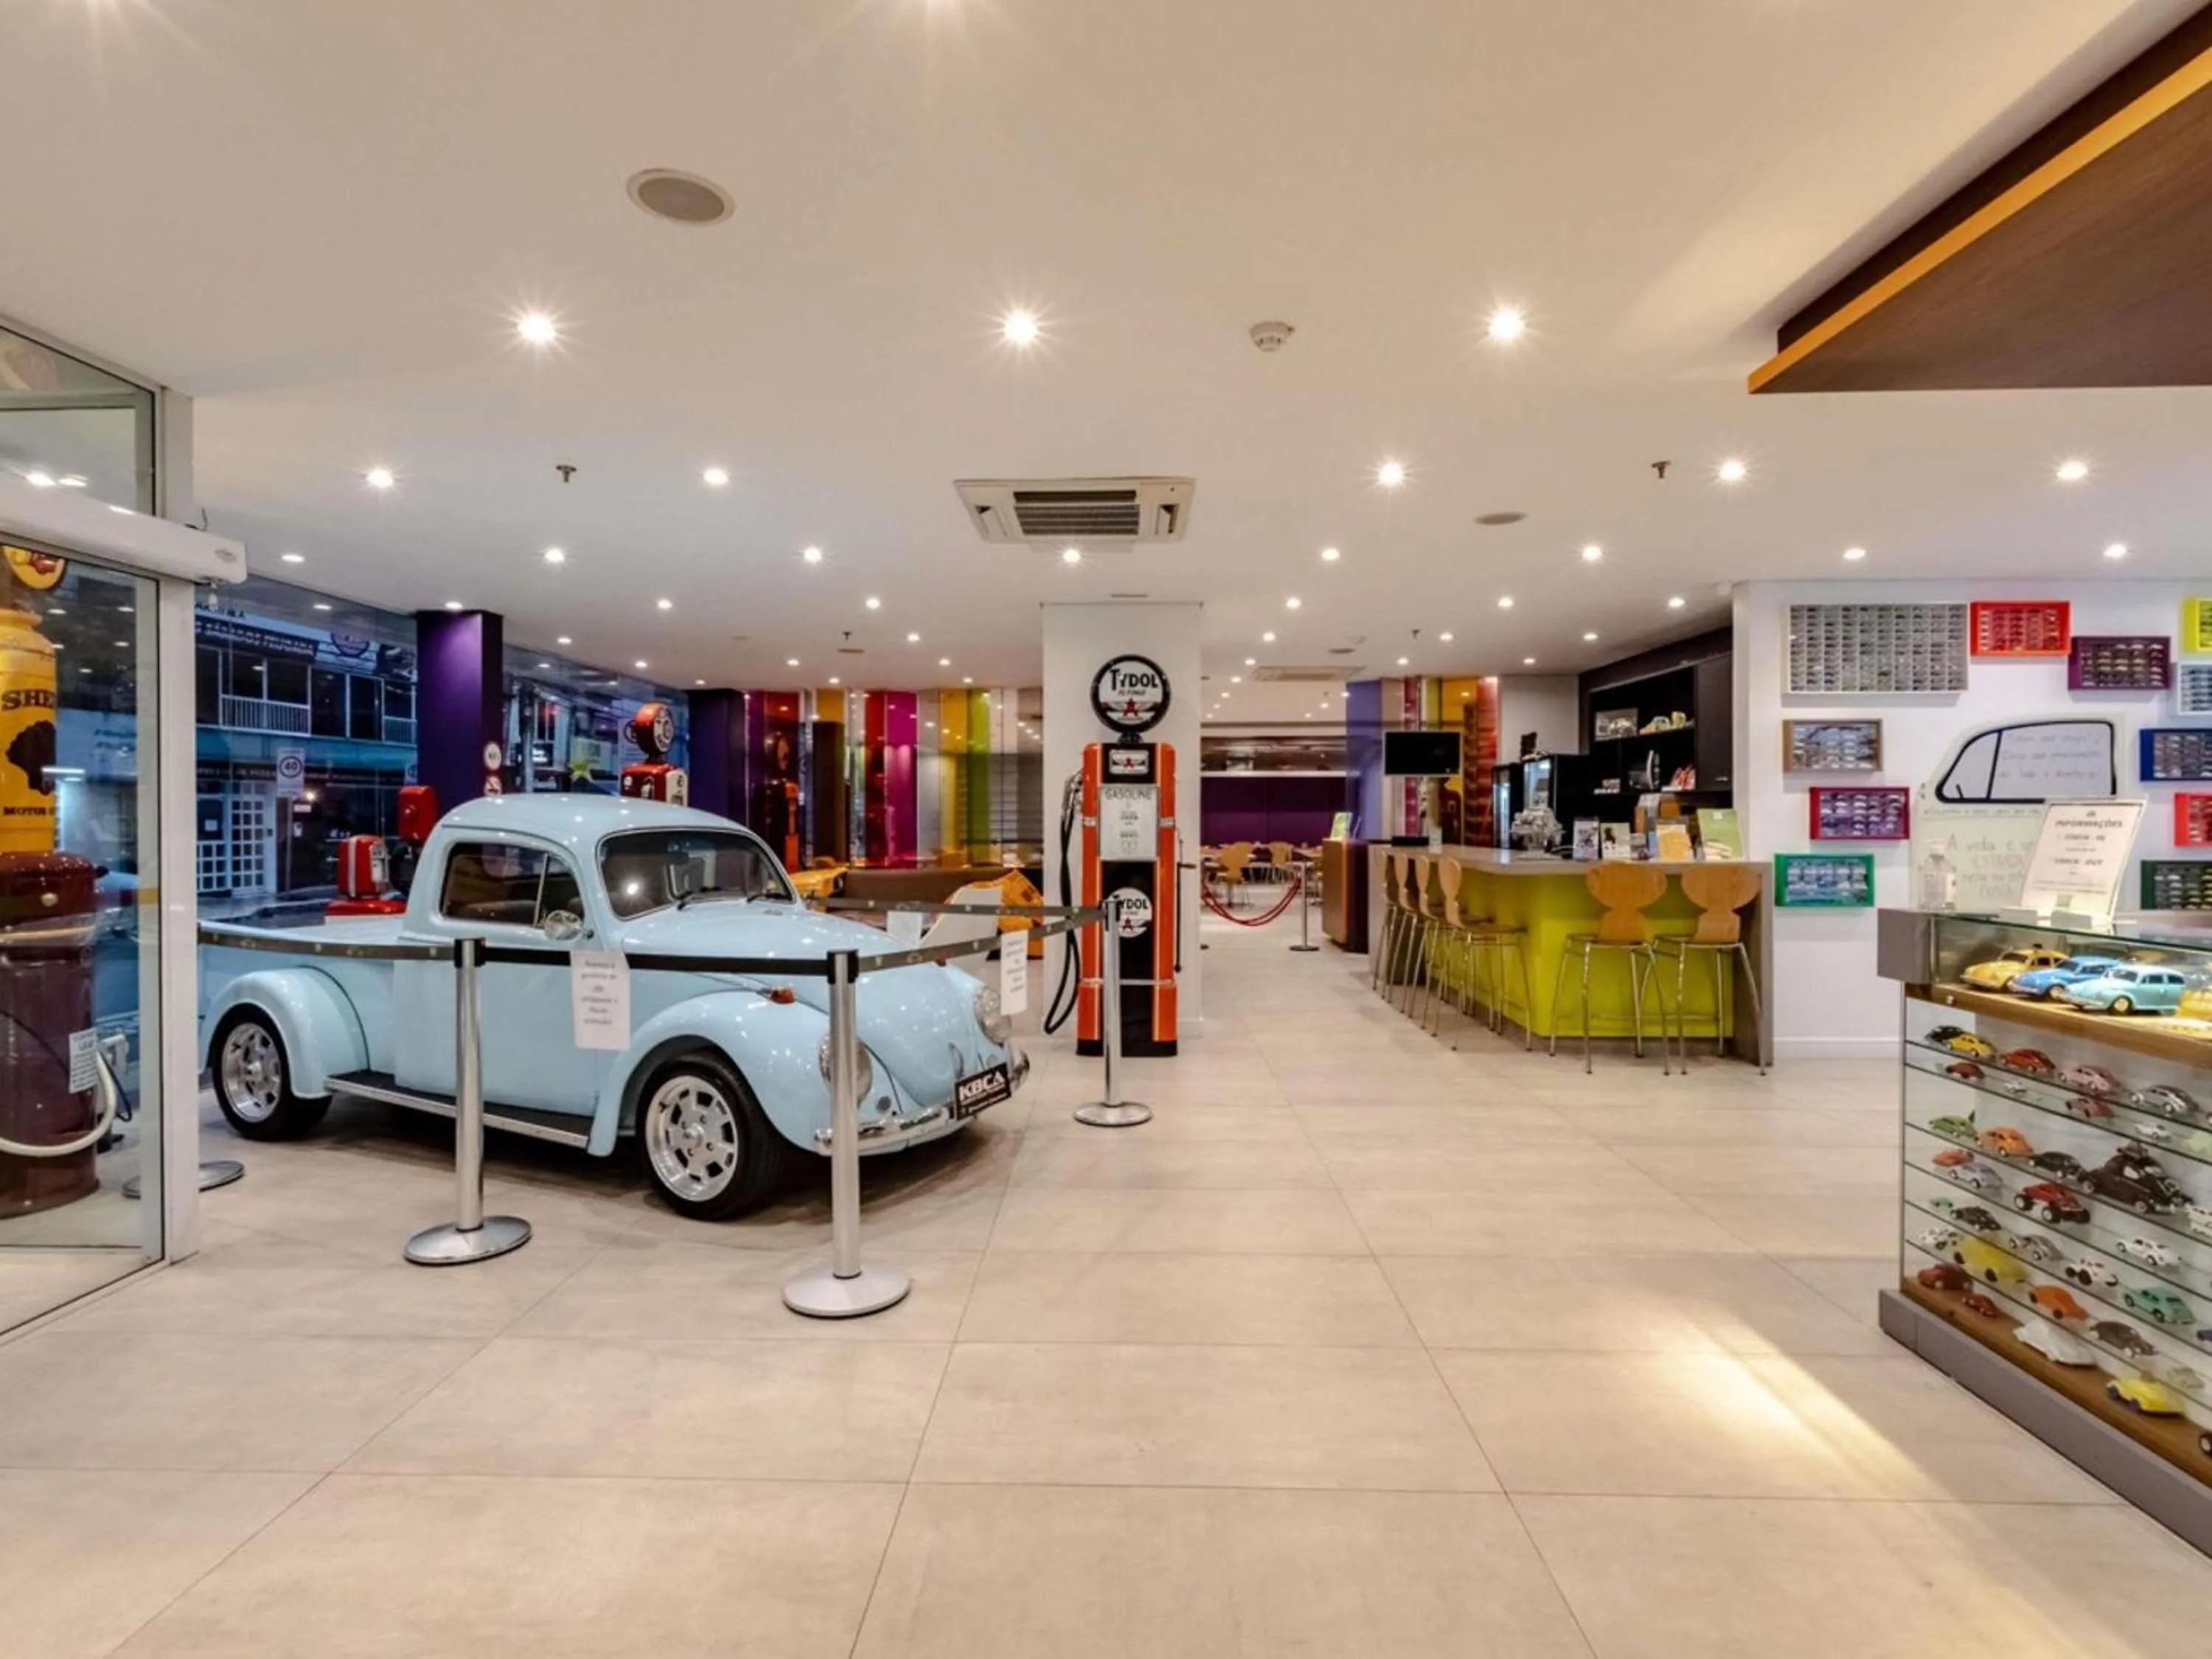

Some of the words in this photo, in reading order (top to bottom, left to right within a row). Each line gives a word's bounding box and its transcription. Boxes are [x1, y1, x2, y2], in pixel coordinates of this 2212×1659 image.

[1110, 668, 1159, 691] TYDOL
[1105, 787, 1153, 801] GASOLINE
[2054, 818, 2124, 829] INFORMAÇÕES
[959, 1071, 1005, 1102] KBCA
